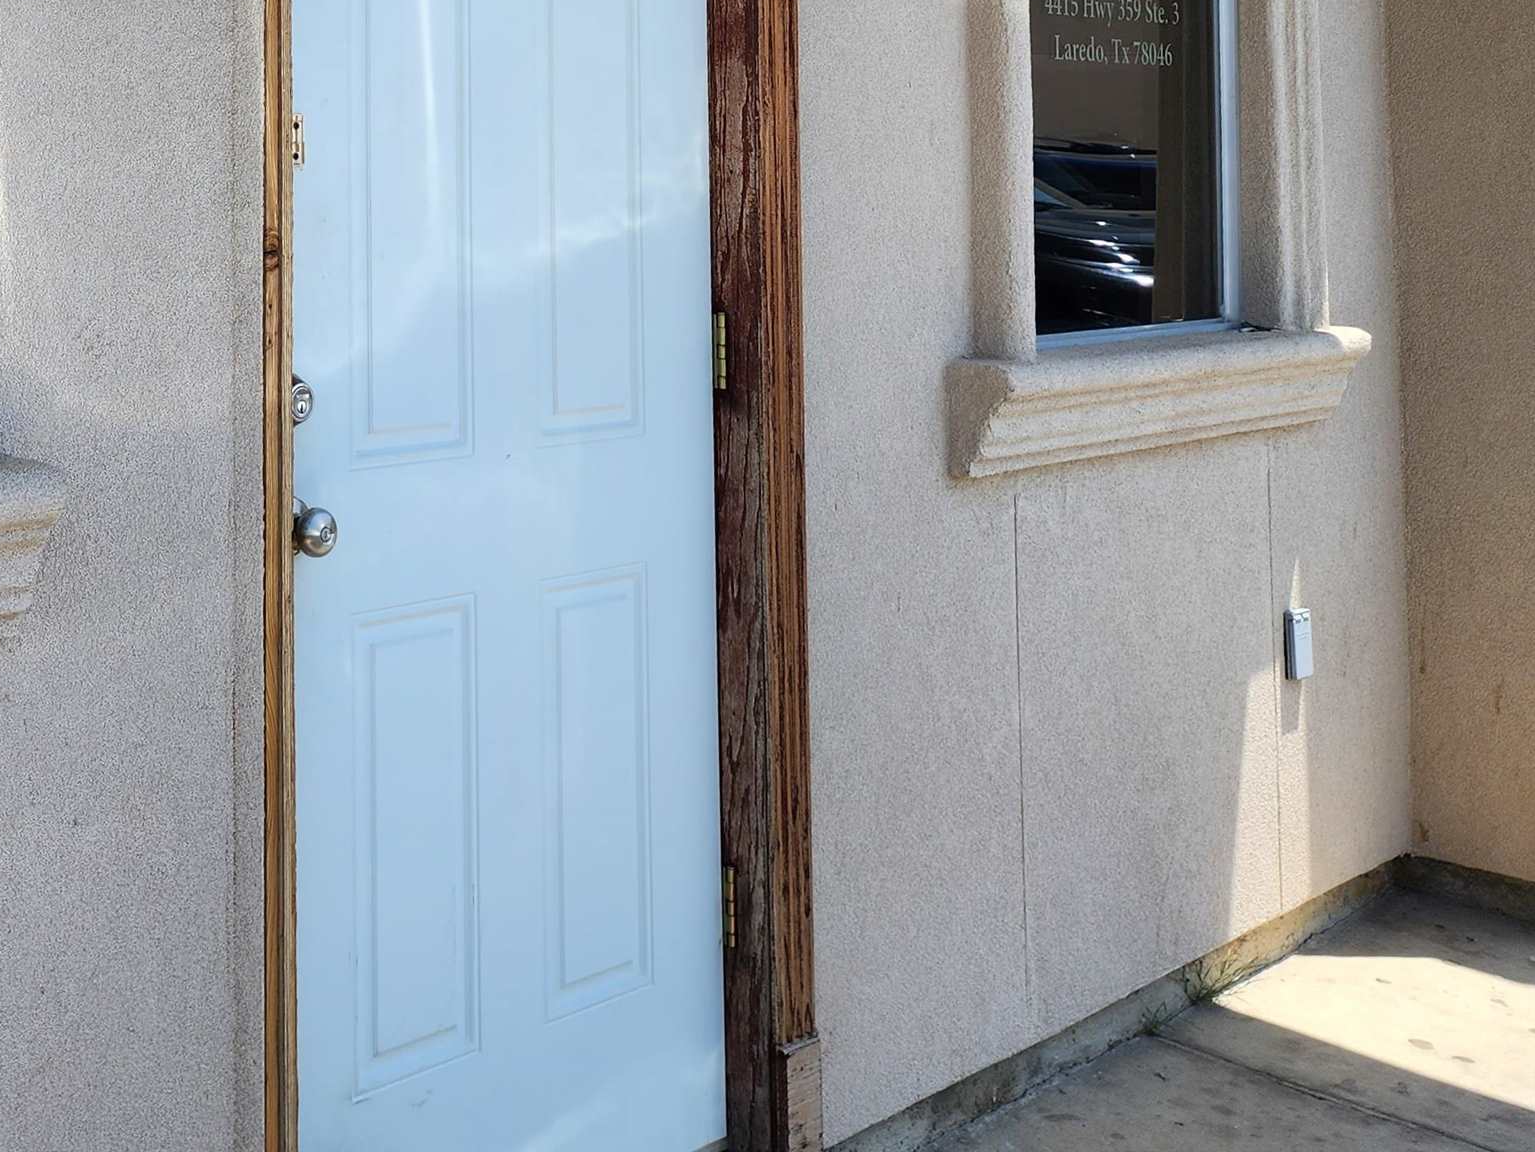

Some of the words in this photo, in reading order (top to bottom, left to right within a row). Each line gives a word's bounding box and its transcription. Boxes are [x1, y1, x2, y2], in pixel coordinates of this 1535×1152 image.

[1172, 2, 1180, 25] 3
[1054, 34, 1108, 65] Laredo,
[1111, 38, 1130, 64] Tx
[1133, 41, 1173, 66] 78046
